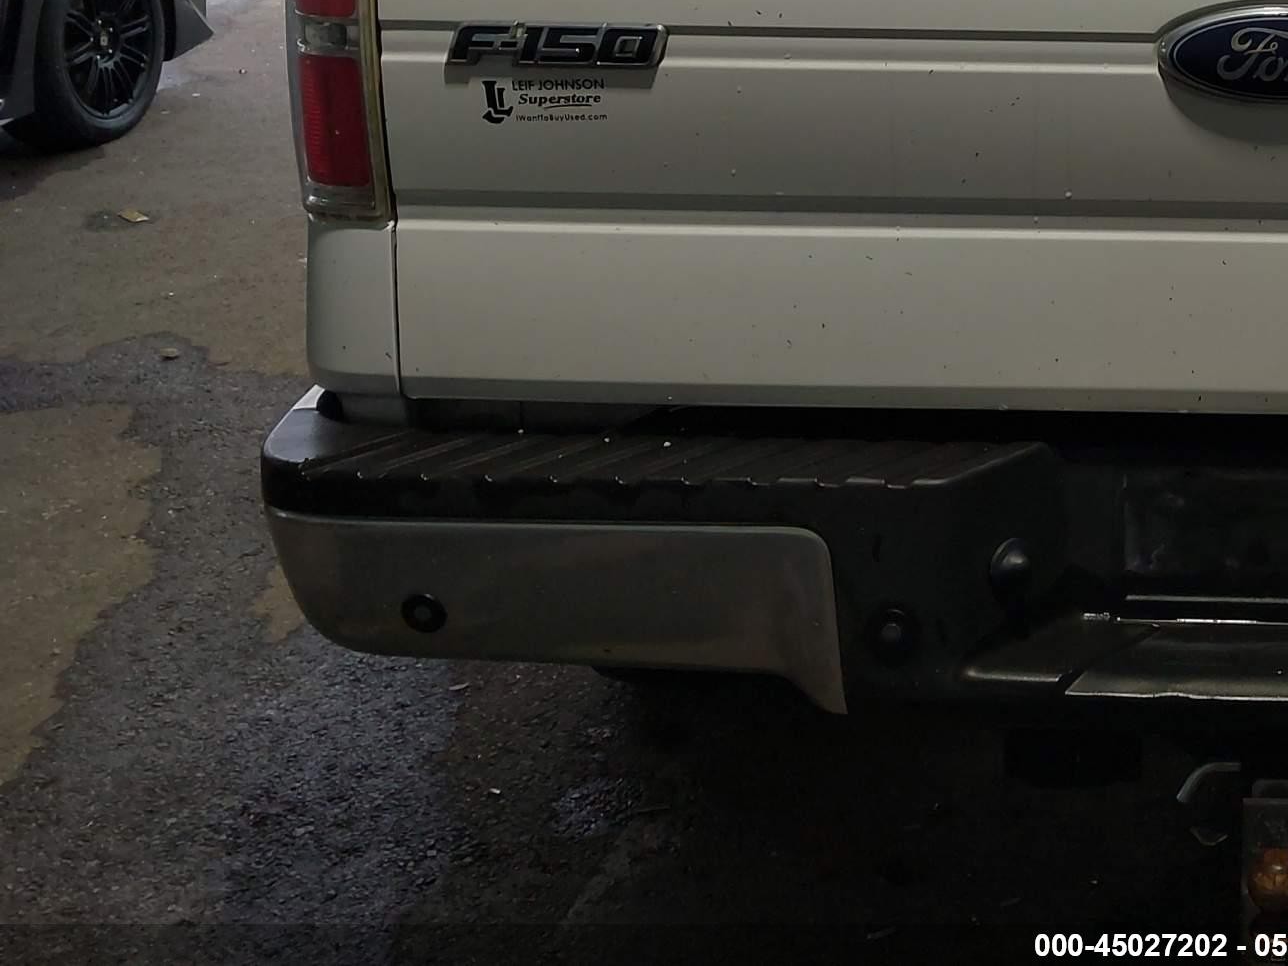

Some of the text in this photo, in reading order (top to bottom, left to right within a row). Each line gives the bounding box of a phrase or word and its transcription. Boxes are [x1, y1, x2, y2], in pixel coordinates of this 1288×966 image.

[448, 23, 668, 67] F-150
[512, 78, 605, 91] LEIF JOHNSON
[518, 93, 601, 105] Superstore
